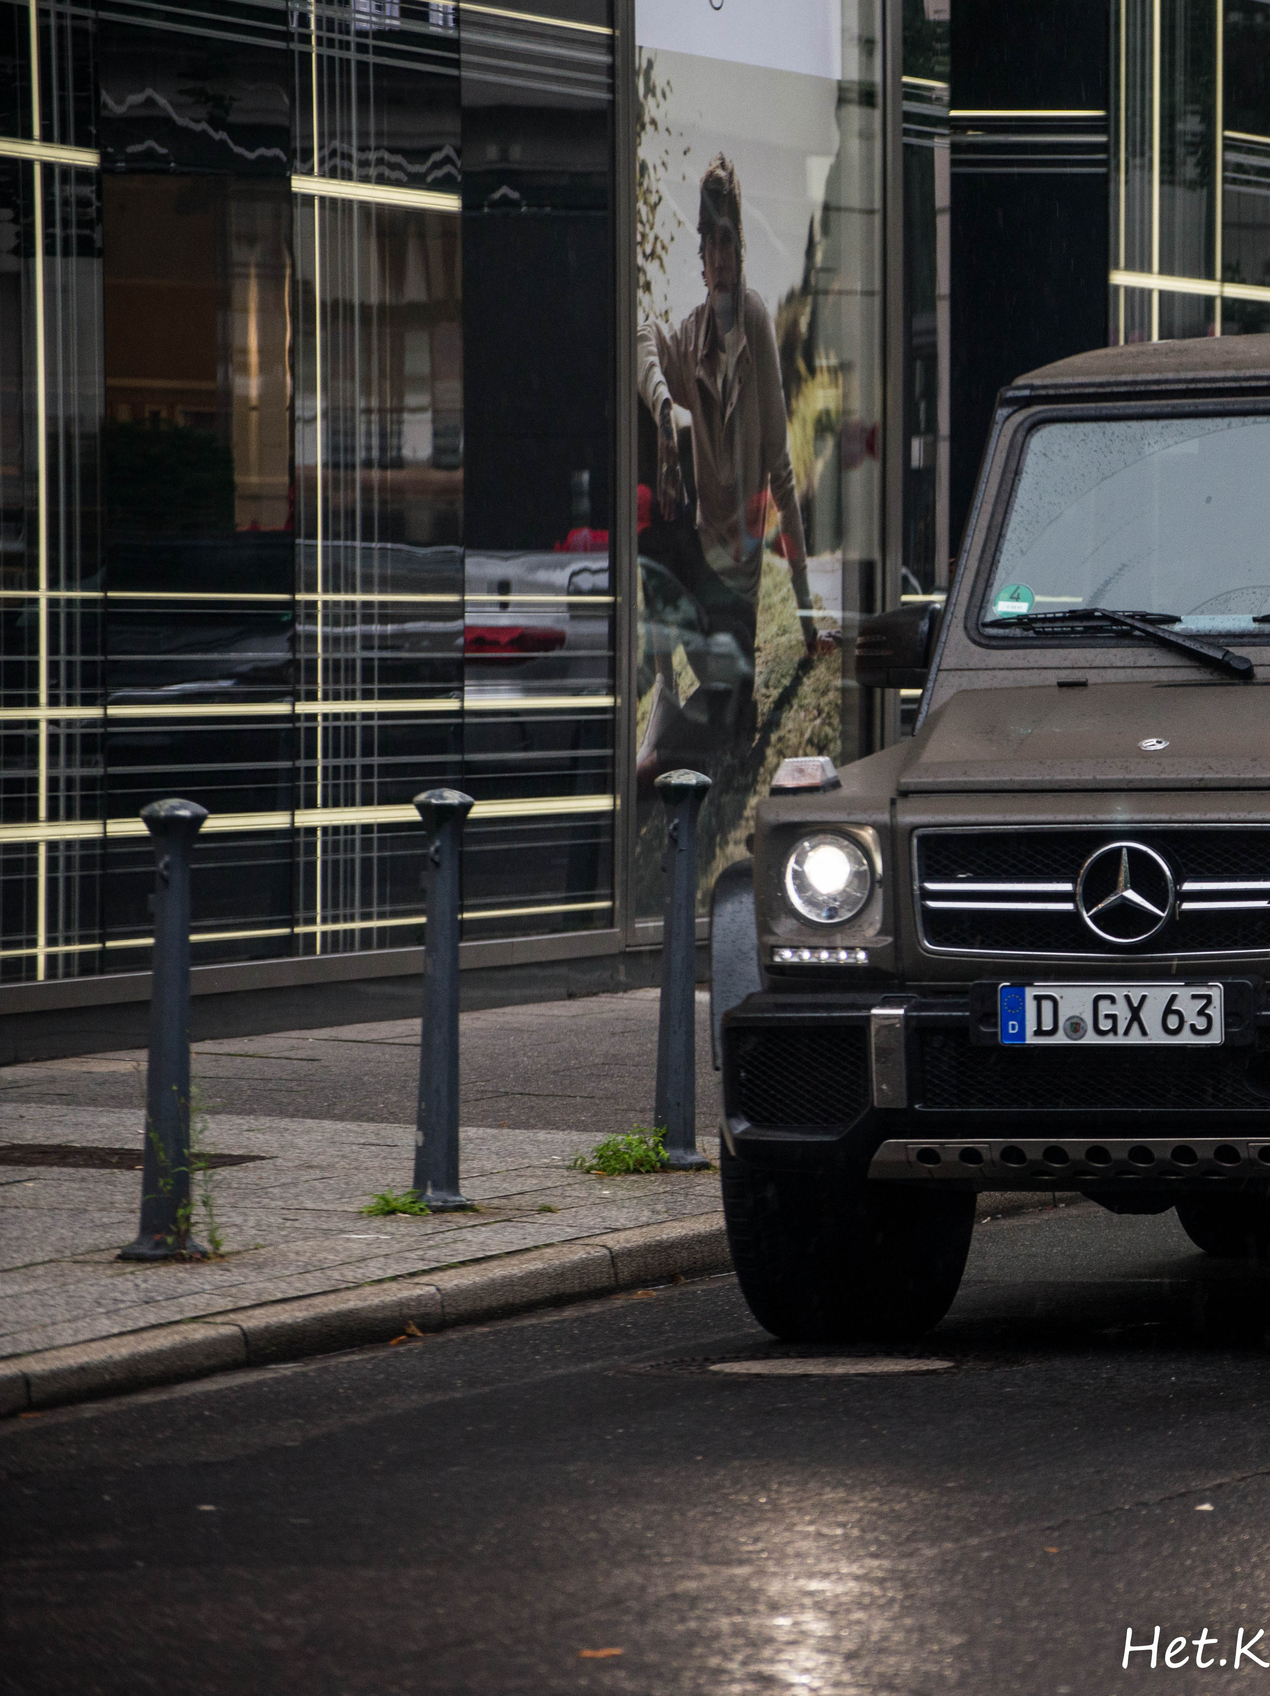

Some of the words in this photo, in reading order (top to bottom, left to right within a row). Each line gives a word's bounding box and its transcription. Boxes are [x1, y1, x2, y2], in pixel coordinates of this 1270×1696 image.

[1009, 585, 1021, 602] 4
[1033, 993, 1060, 1037] D
[1092, 993, 1149, 1037] GX
[1161, 993, 1214, 1037] 63
[1008, 1020, 1019, 1034] D
